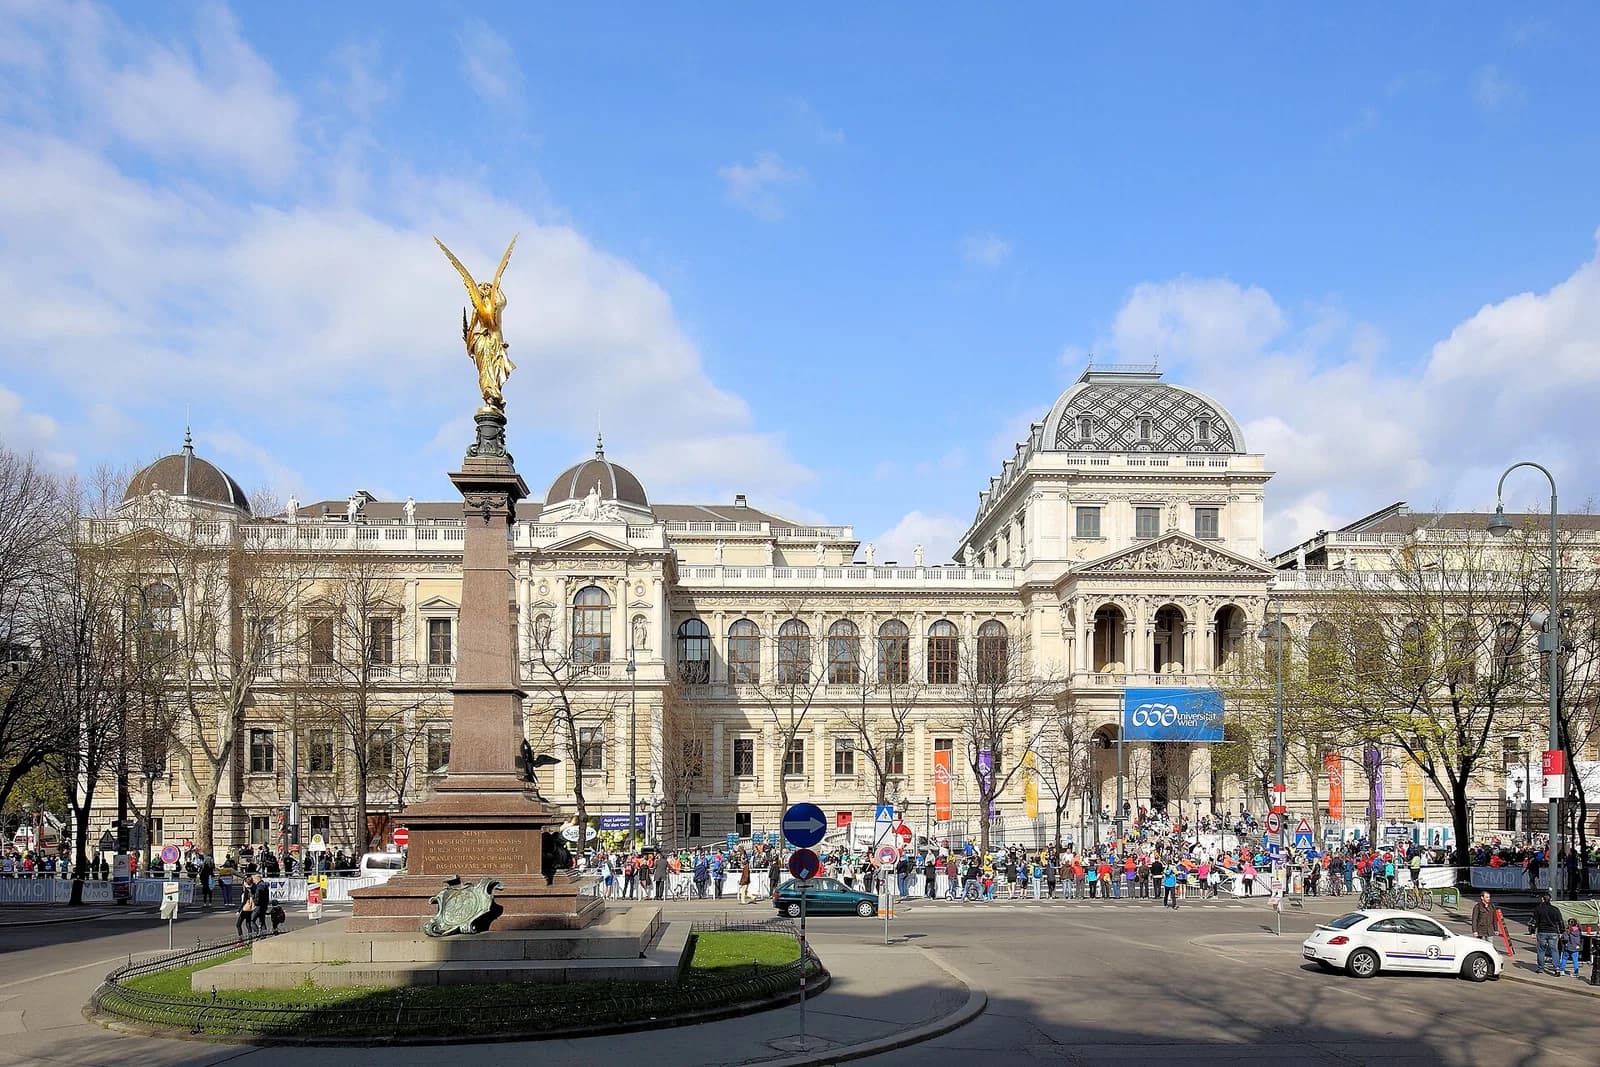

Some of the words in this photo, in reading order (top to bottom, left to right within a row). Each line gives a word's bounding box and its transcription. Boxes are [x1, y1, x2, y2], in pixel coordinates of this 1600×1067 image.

[1132, 703, 1177, 727] 650
[1177, 719, 1198, 727] wien
[1428, 947, 1439, 957] 53
